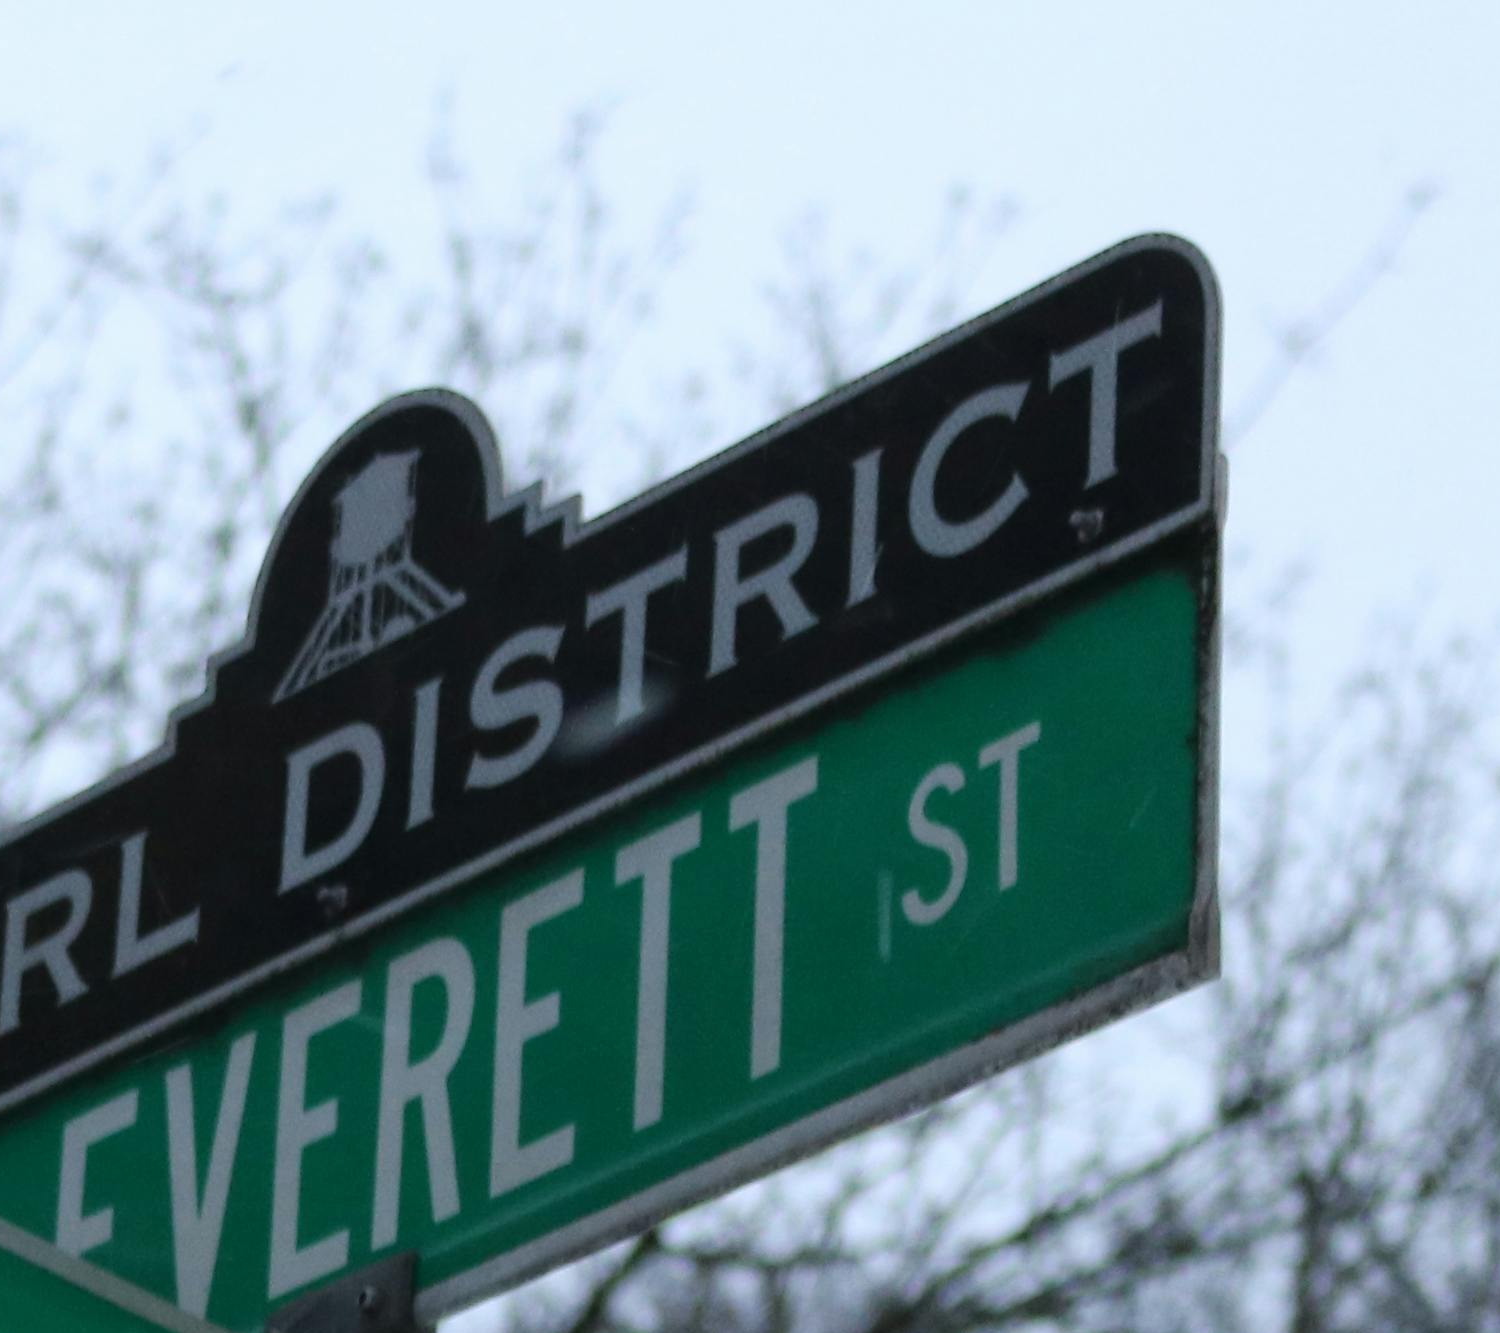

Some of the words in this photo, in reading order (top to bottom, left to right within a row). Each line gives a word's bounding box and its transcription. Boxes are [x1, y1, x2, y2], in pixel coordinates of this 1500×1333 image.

[277, 298, 1164, 893] DISTRICT
[55, 756, 820, 1322] EVERETT
[899, 720, 1042, 928] ST
